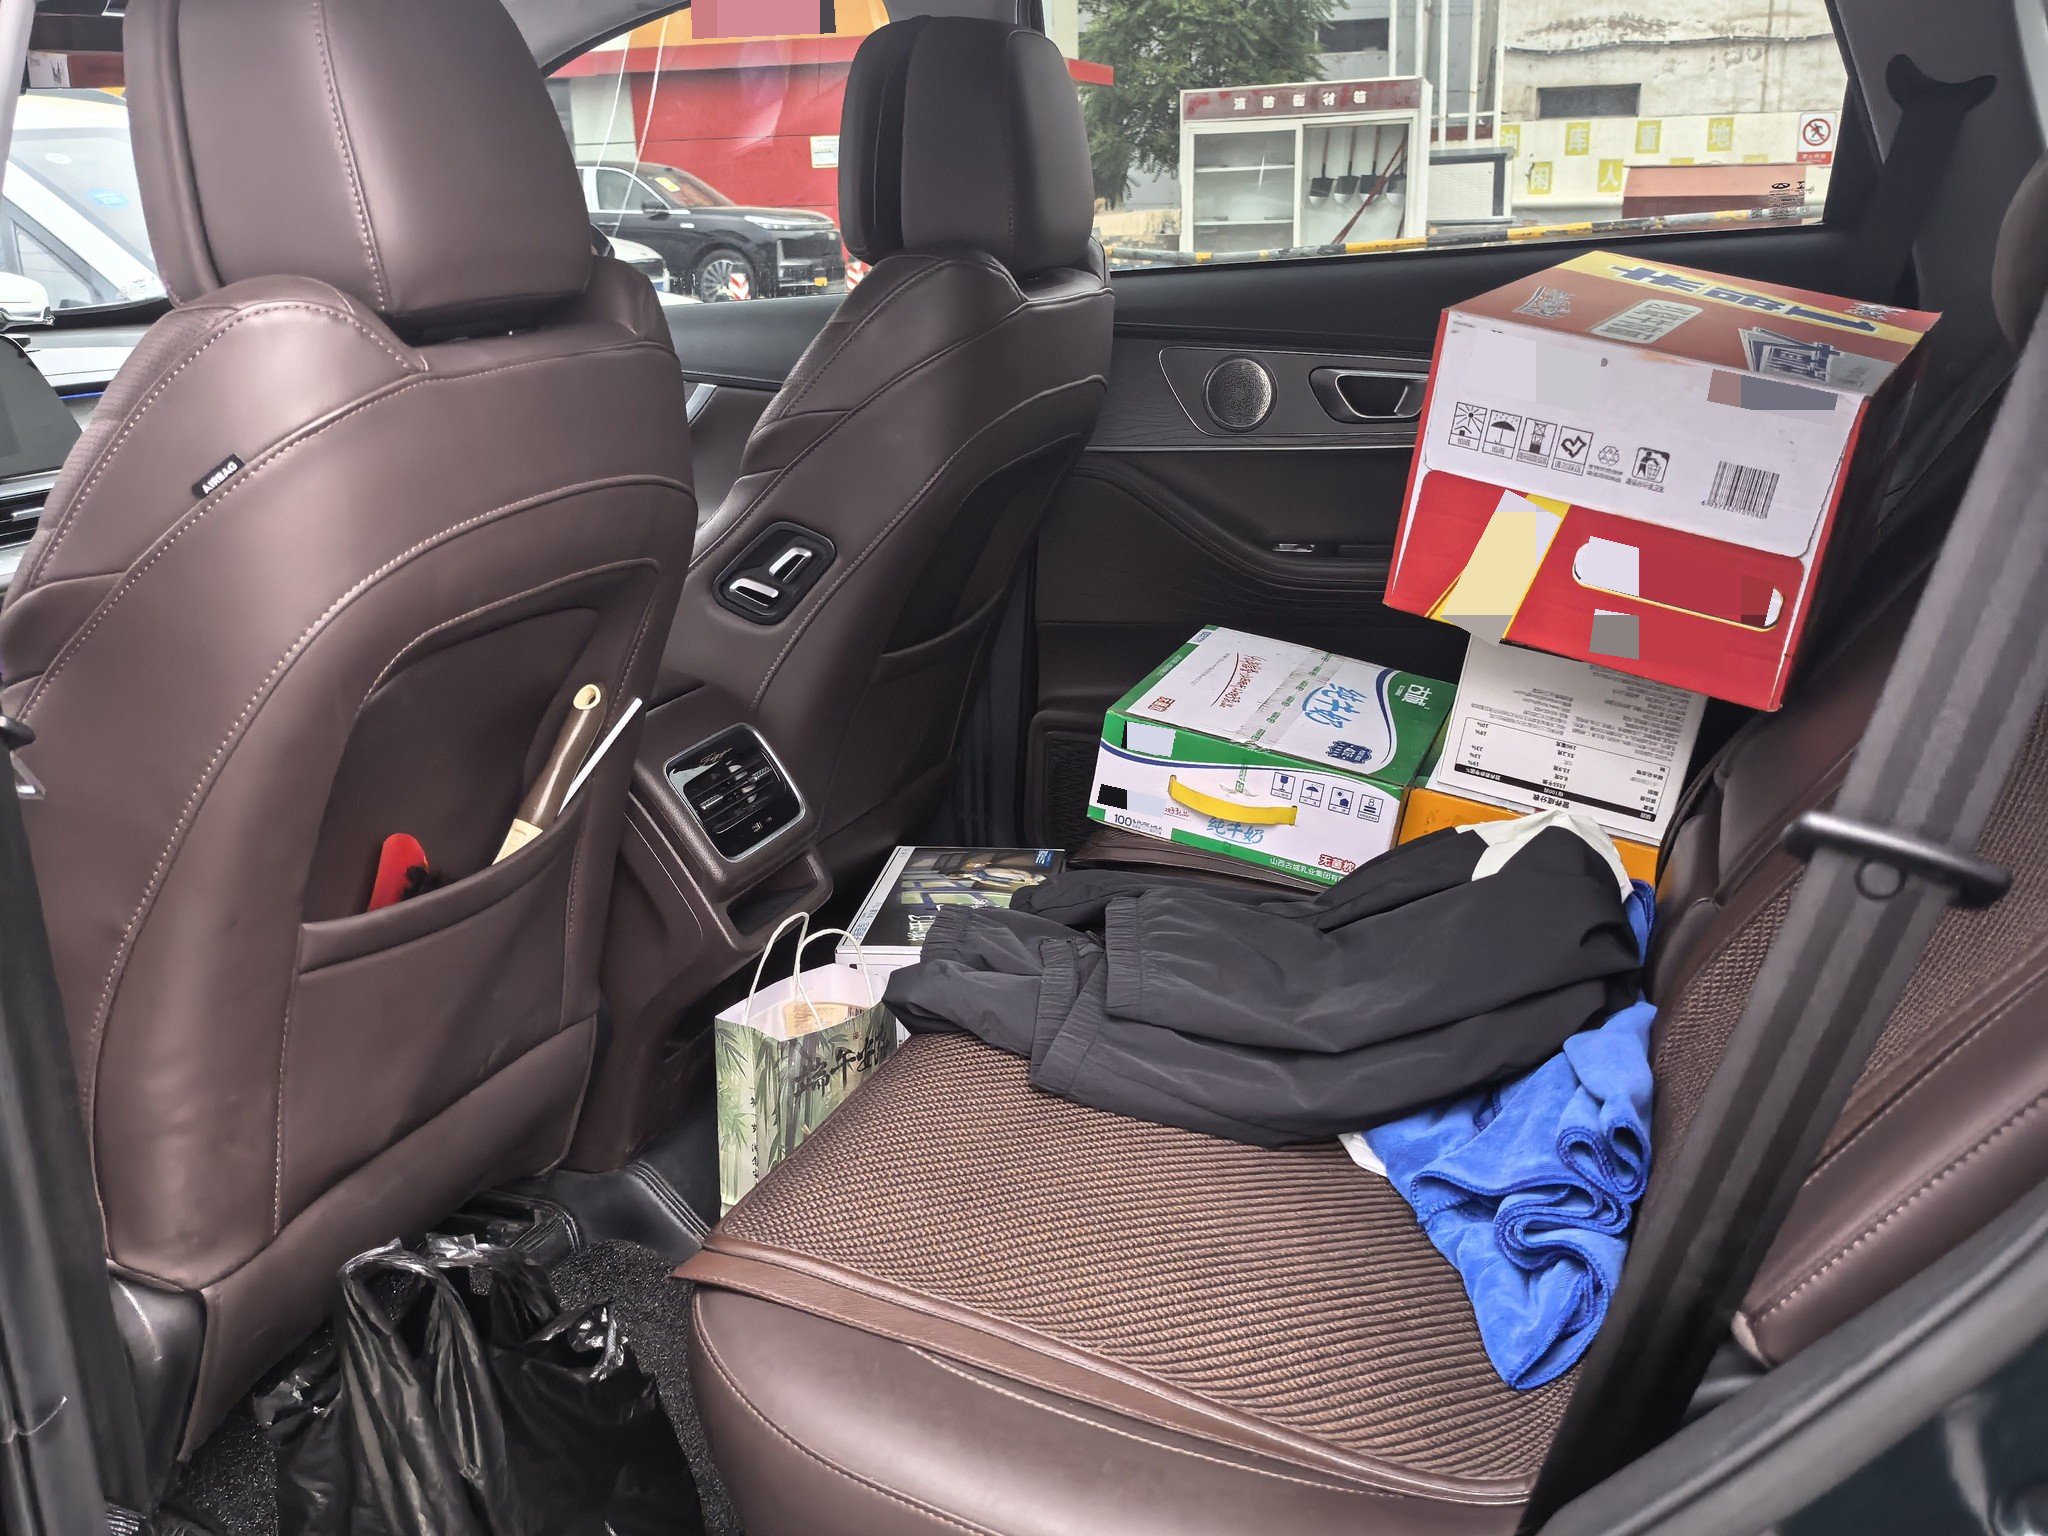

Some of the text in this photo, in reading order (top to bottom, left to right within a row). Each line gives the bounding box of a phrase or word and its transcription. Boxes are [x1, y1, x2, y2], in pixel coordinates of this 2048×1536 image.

[201, 461, 238, 495] AIRBAG
[1304, 683, 1367, 729] 纯牛奶
[1401, 683, 1432, 706] 古城
[1556, 749, 1575, 758] 53.2克
[1551, 764, 1571, 773] 13.9克
[1531, 792, 1570, 809] 营养成分表
[1206, 817, 1265, 844] 纯牛奶
